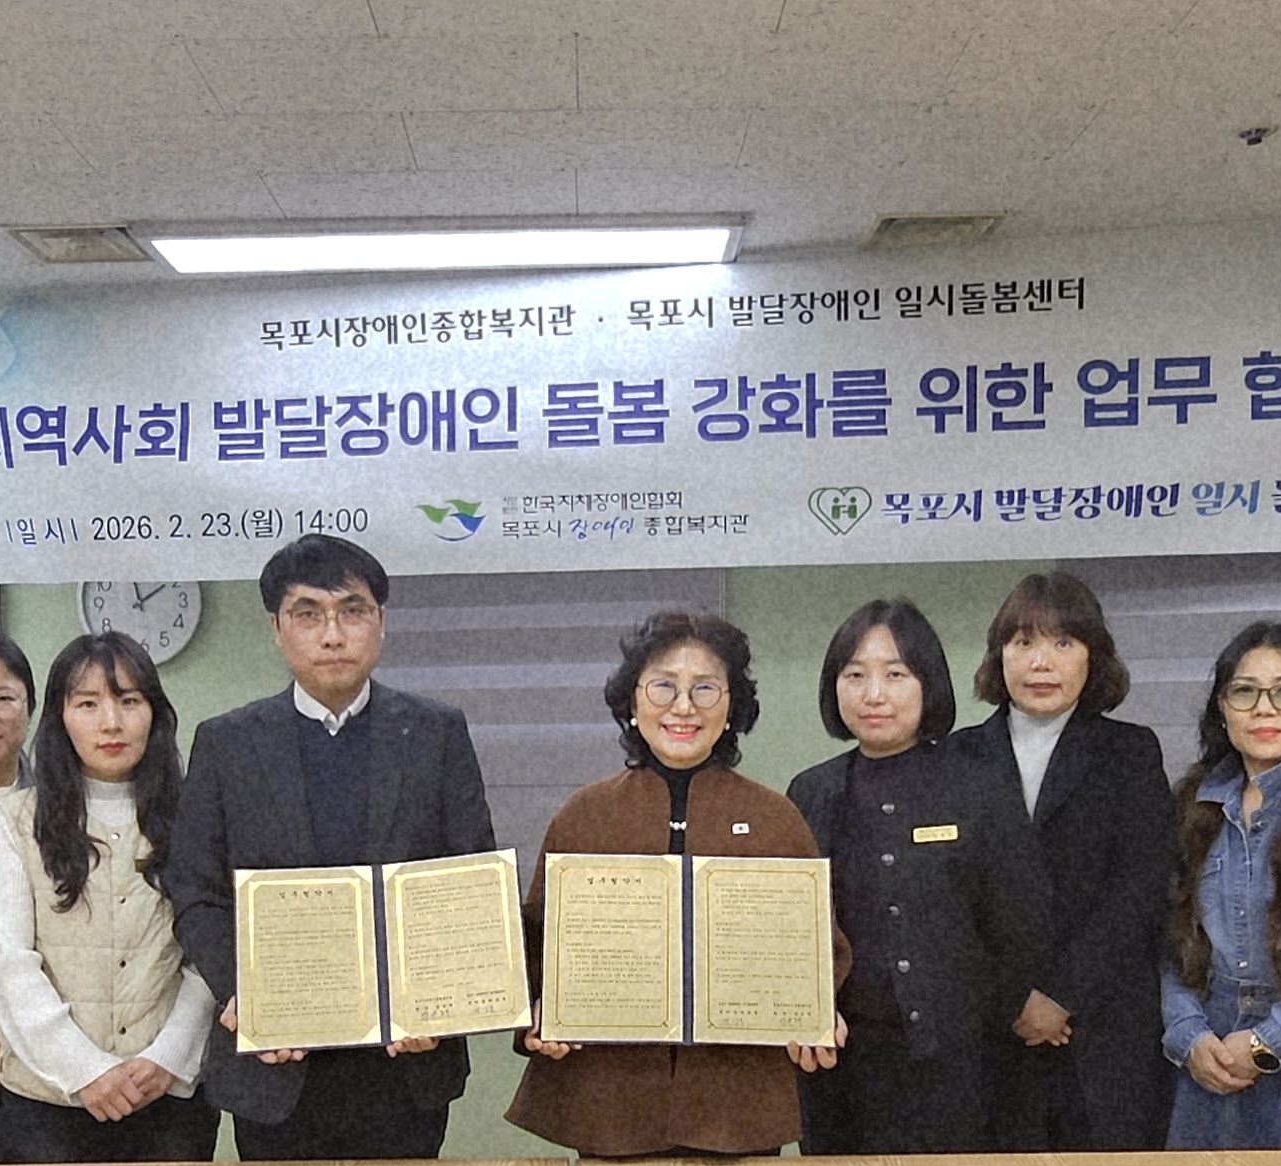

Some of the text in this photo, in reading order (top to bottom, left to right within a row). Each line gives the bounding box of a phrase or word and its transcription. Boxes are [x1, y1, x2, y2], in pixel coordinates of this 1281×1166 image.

[260, 276, 1088, 351] 목포시장애인종합복지관 목포시 발달장애인 일시돌봄센터
[213, 385, 519, 460] 발달장애인
[541, 378, 670, 450] 돌봄
[691, 369, 892, 442] 강화를
[915, 361, 1053, 435] 위한
[1076, 354, 1217, 429] 업무
[522, 492, 683, 514] 한국지체장애인협회
[882, 487, 982, 524] 목포시
[994, 479, 1180, 521] 발달장애인
[1191, 478, 1260, 517] 일시
[91, 516, 159, 541] 2026.
[169, 515, 191, 539] 2.
[201, 508, 283, 540] 23.(월)
[294, 508, 368, 534] 14:00
[502, 519, 562, 539] 목포시
[645, 514, 749, 536] 종합복지관
[93, 596, 105, 613] 9
[178, 591, 188, 609] 3
[172, 612, 184, 629] 4
[159, 630, 170, 648] 5
